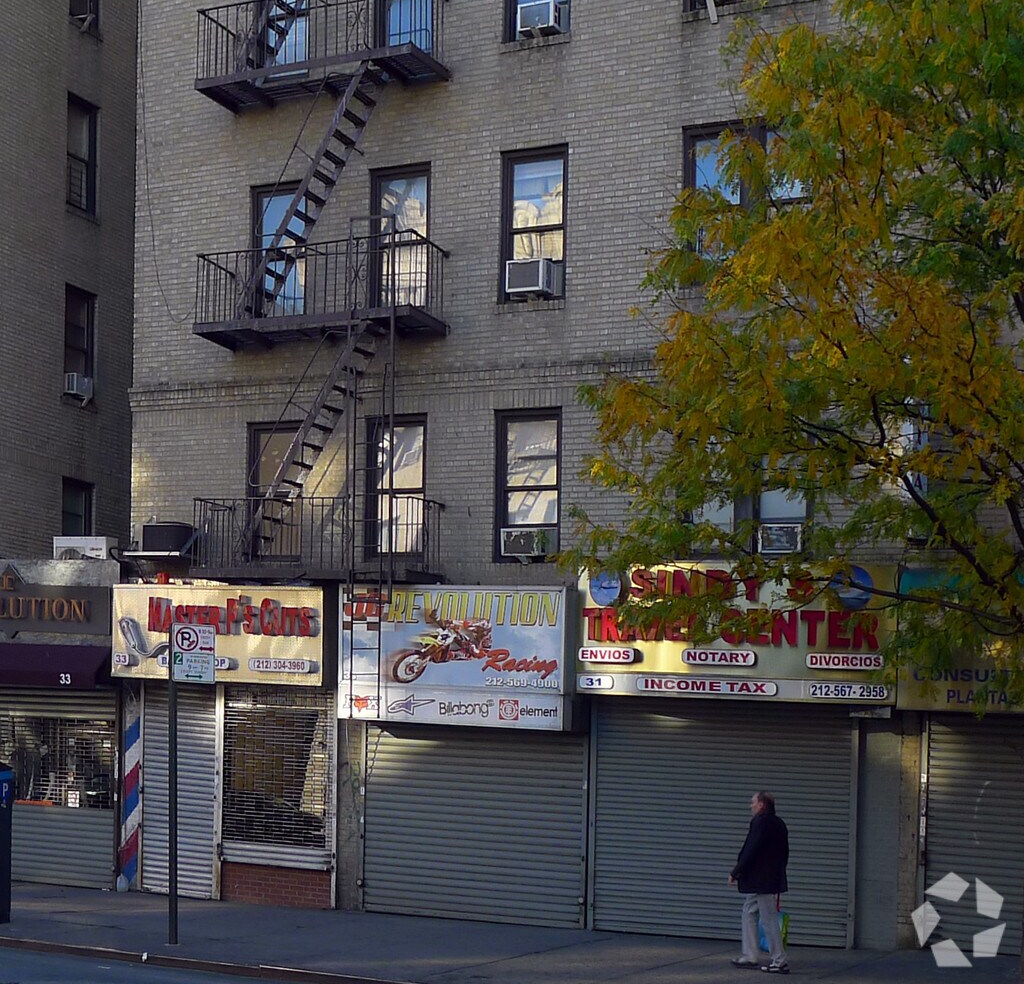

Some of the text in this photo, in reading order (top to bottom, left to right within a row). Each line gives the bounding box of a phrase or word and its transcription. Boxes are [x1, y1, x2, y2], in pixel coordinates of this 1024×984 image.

[387, 591, 560, 626] REVOLUTION
[115, 654, 127, 663] 33
[580, 649, 631, 660] ENVIOS
[685, 651, 751, 664] NOTARY
[482, 648, 558, 679] Racing
[810, 655, 881, 667] DIVORCIOS
[59, 673, 71, 685] 33
[485, 676, 559, 689] 212-569-4900
[586, 677, 602, 687] 31
[643, 679, 767, 694] INCOME TAX
[439, 701, 489, 717] Billabong
[519, 705, 558, 717] element
